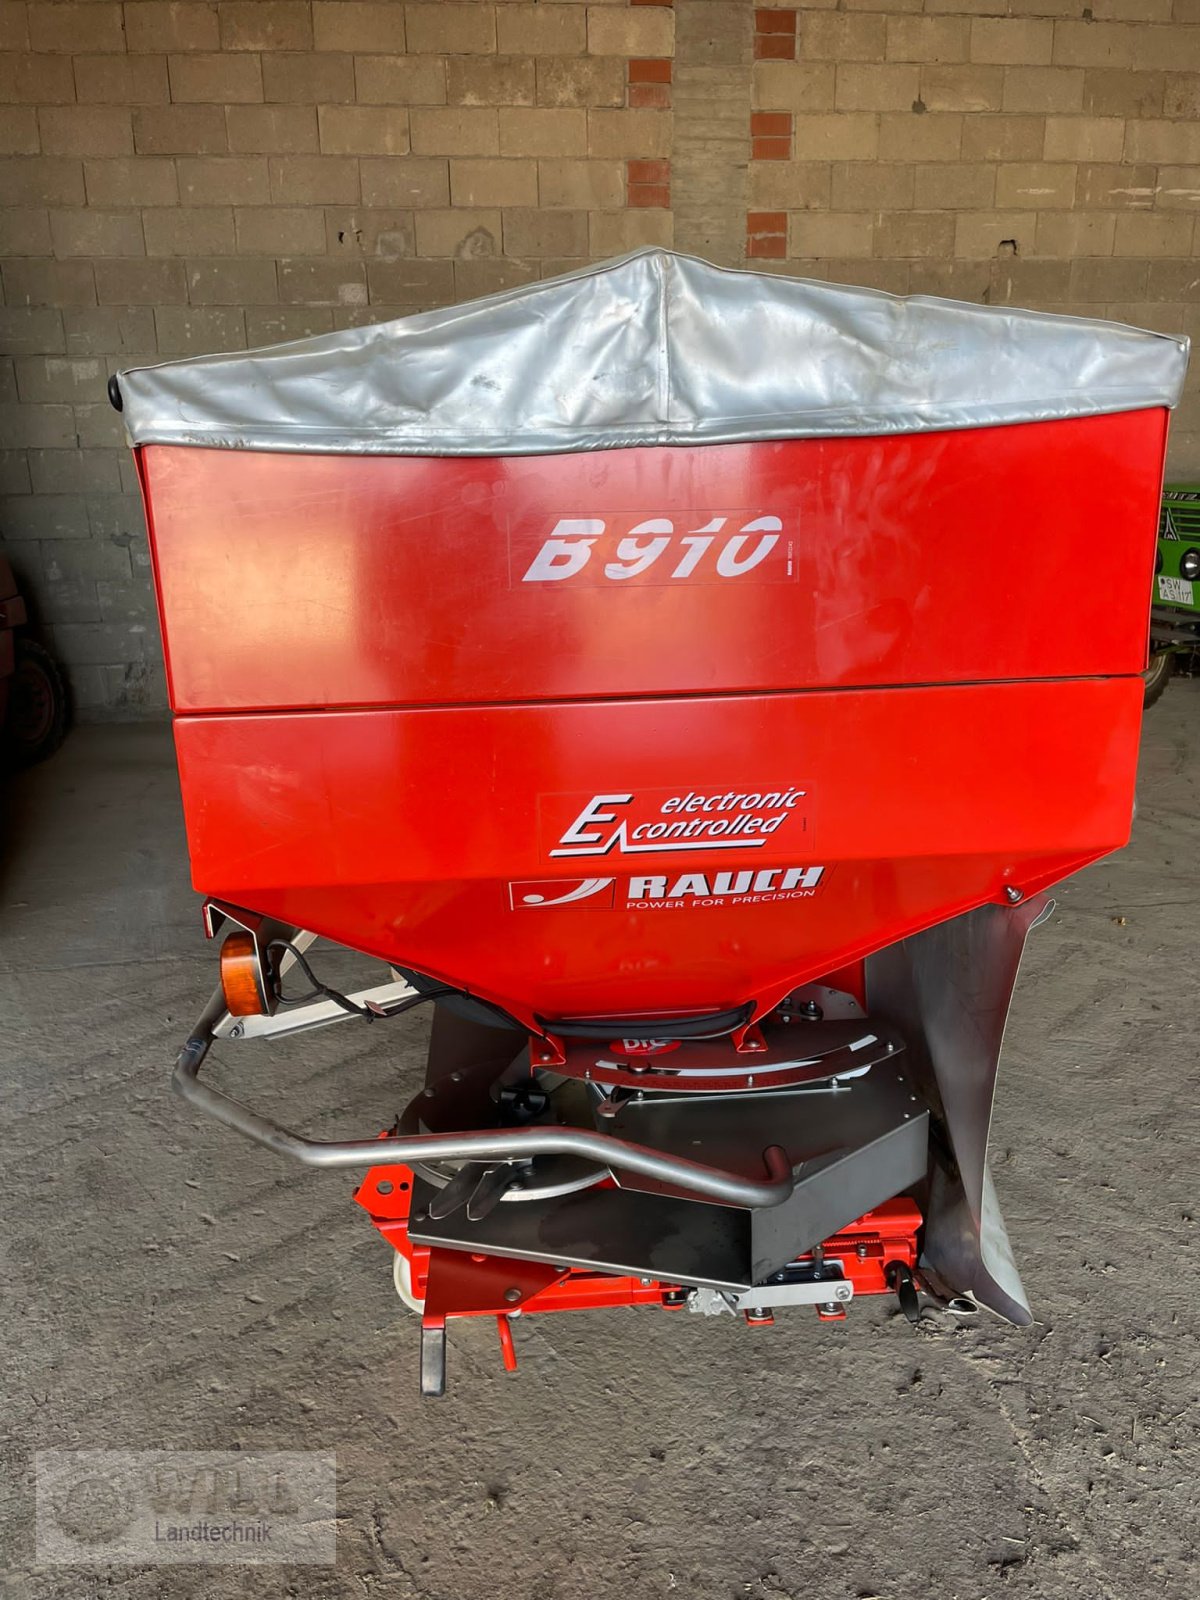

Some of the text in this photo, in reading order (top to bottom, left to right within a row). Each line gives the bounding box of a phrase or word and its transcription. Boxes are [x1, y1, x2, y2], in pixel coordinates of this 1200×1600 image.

[521, 518, 606, 582] B
[604, 515, 783, 580] 910
[660, 787, 806, 814] electronic
[631, 812, 788, 840] controlled
[628, 866, 825, 900] RAUCH
[626, 889, 816, 910] POWER FOR PRECISION
